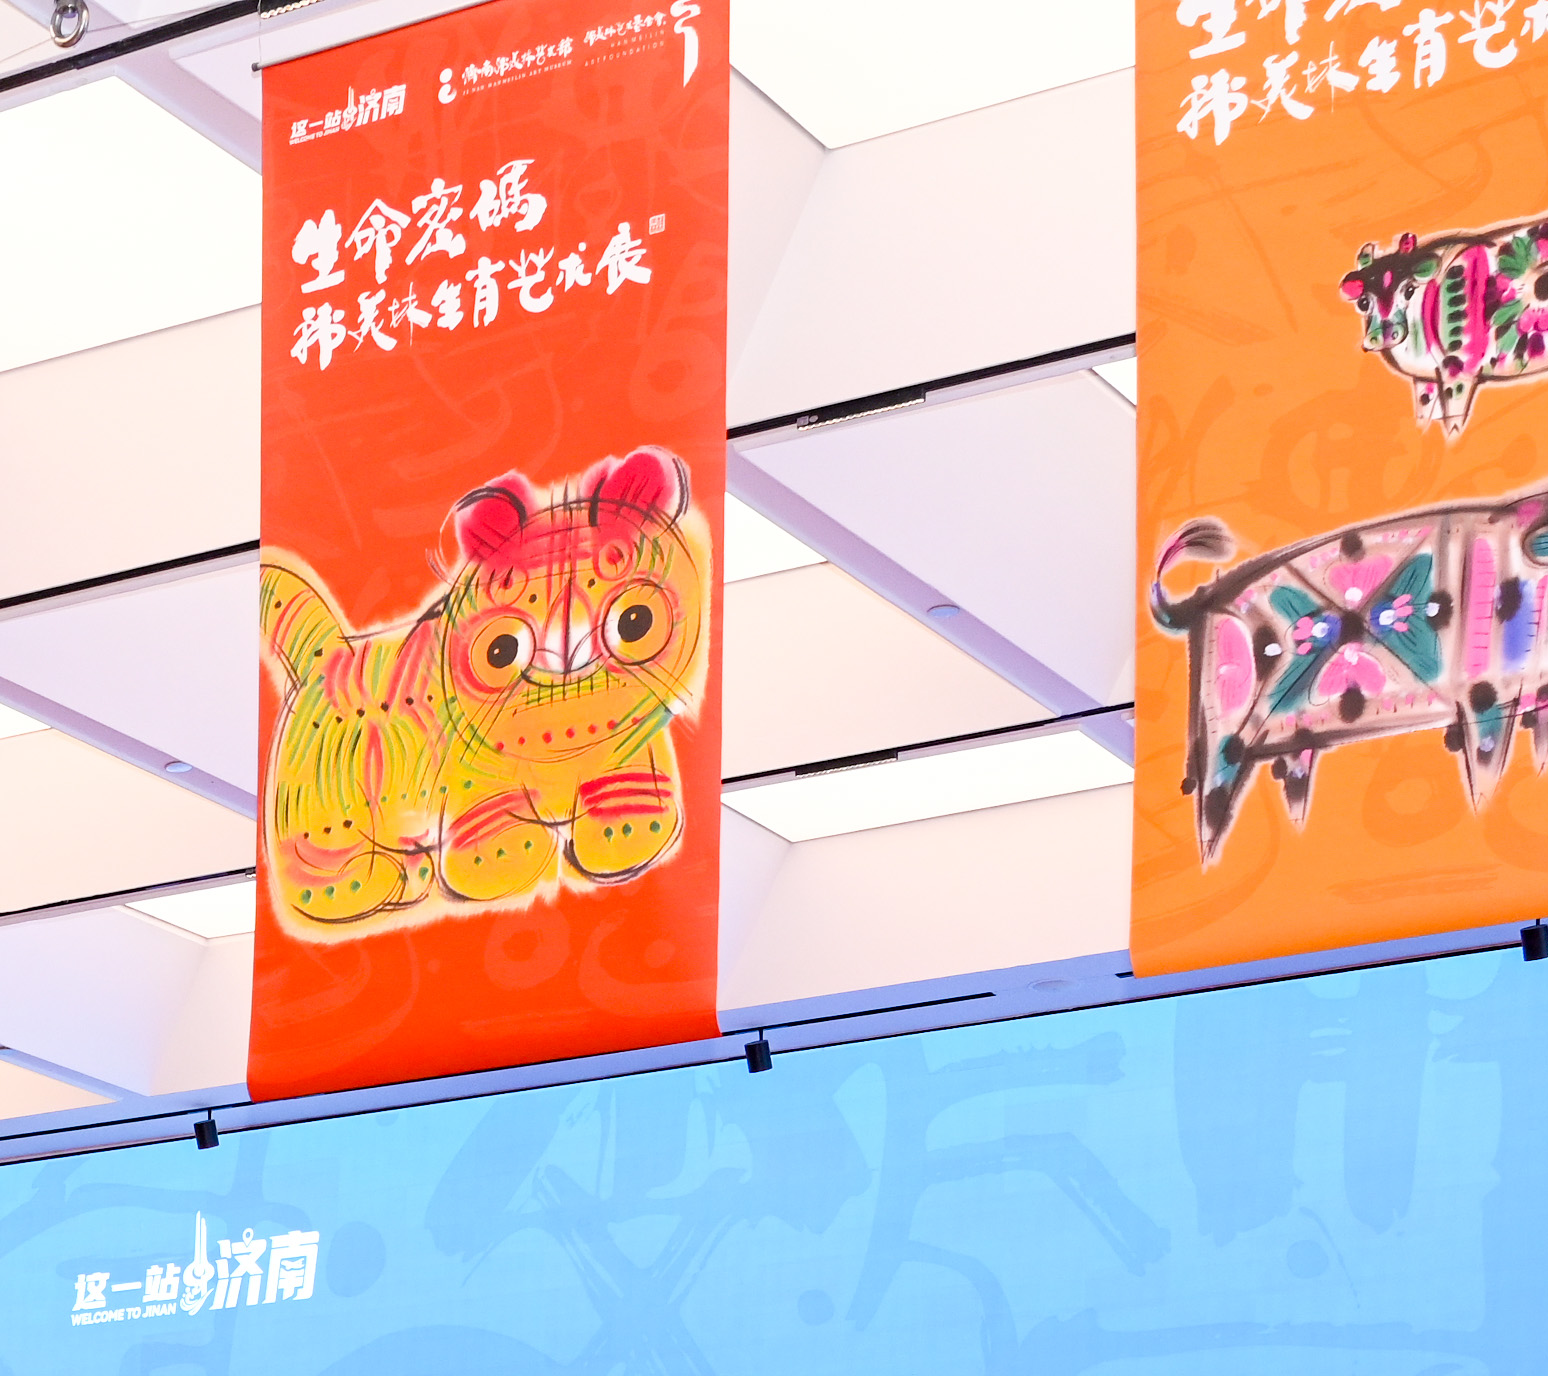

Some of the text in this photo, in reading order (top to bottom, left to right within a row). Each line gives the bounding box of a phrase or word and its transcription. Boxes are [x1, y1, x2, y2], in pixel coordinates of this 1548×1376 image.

[70, 1303, 177, 1327] WELCOME TO JINAN
